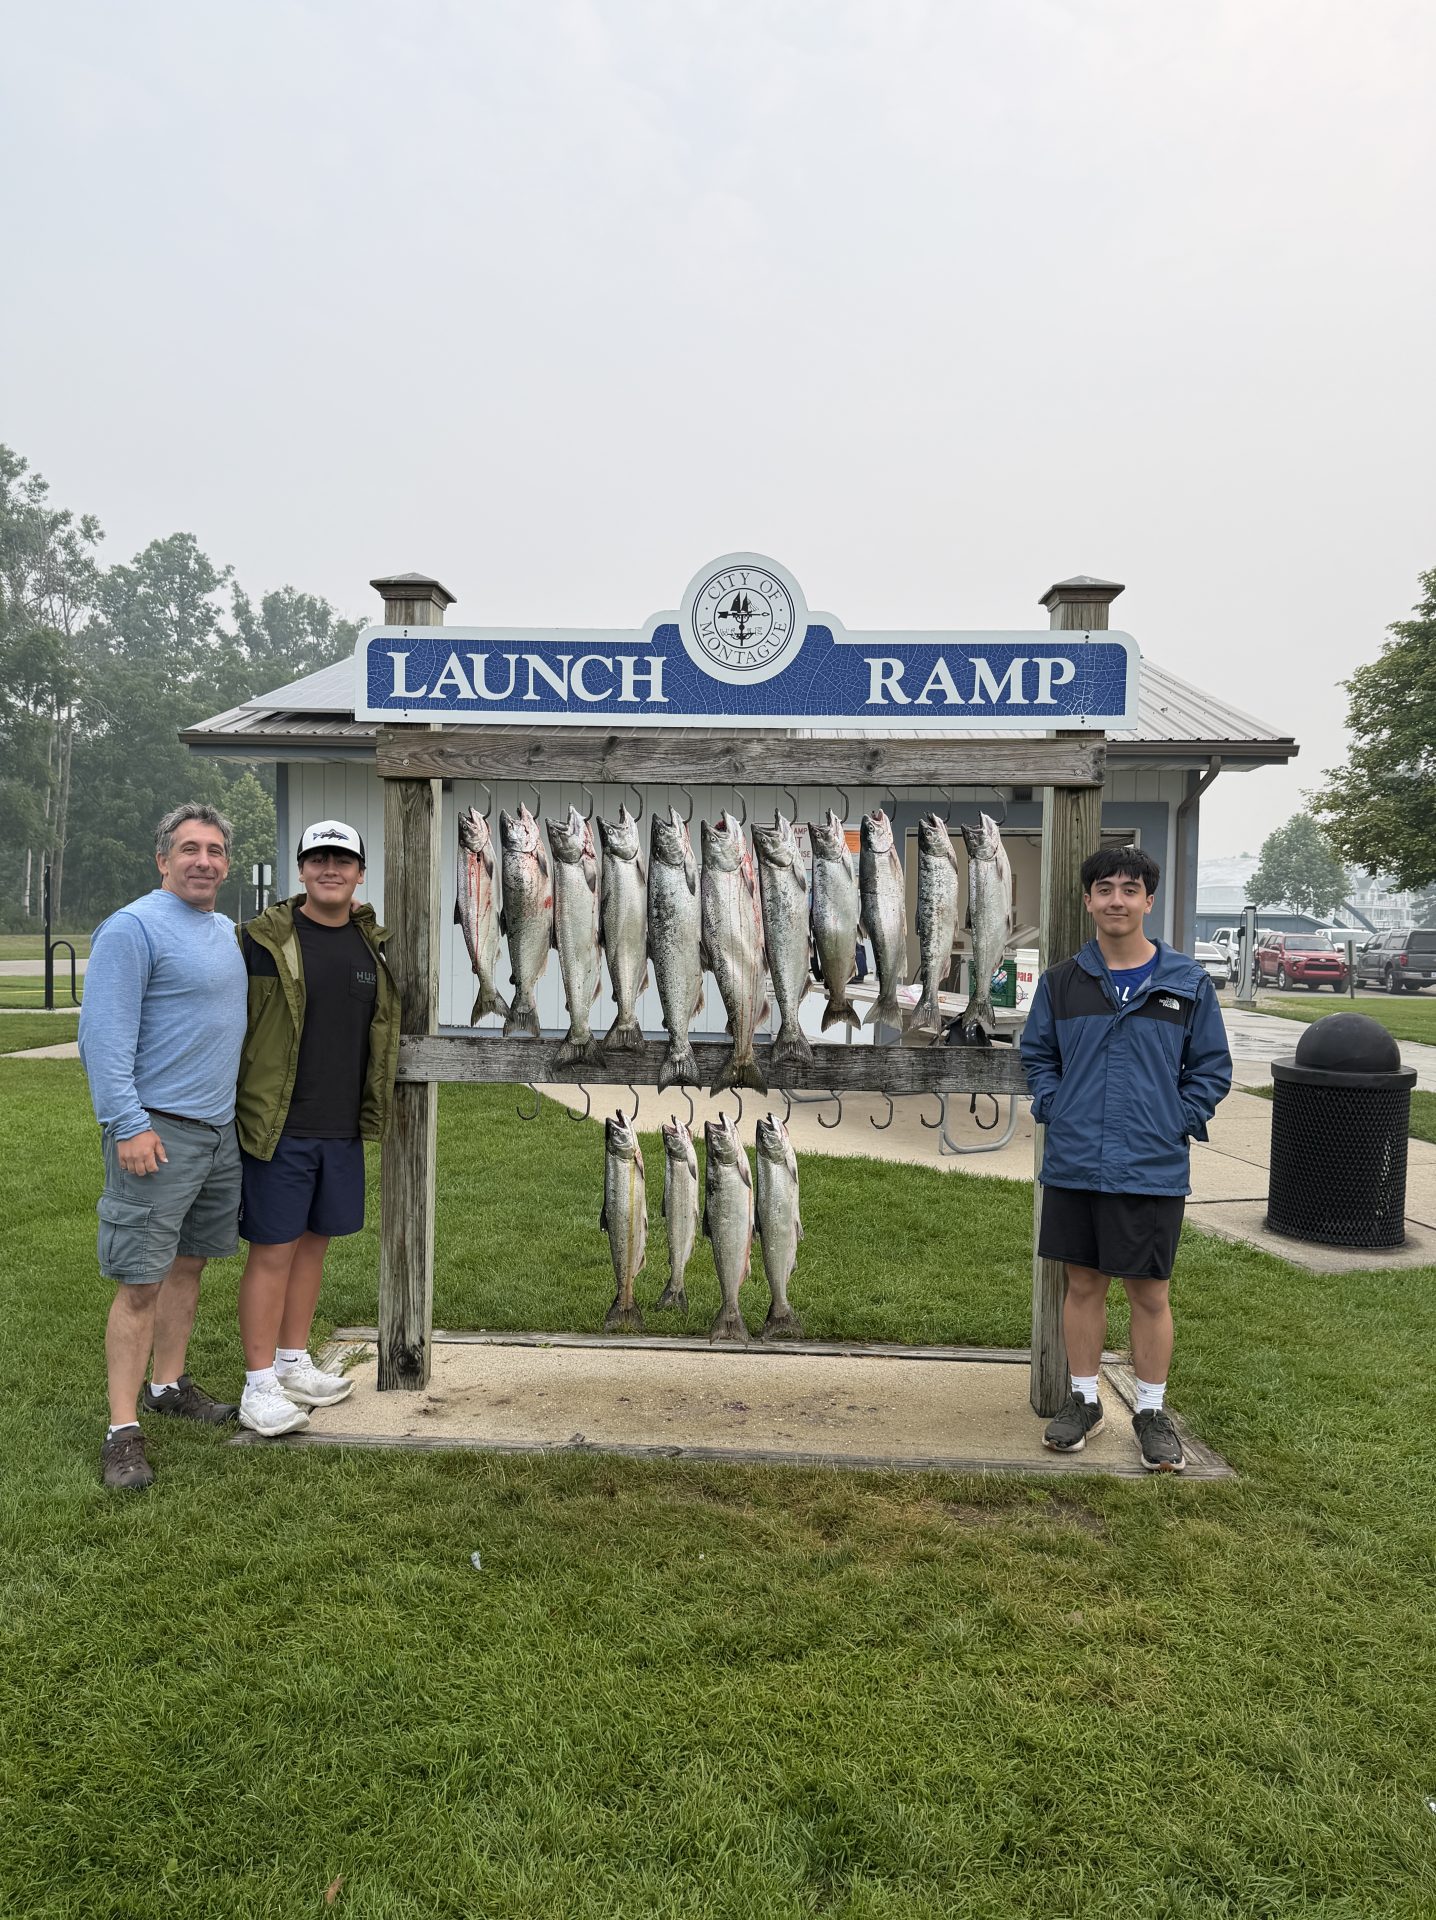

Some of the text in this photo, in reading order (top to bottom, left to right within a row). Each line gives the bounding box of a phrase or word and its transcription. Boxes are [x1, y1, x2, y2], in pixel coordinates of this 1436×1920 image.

[707, 572, 783, 601] CITY OF
[699, 621, 787, 664] MONTAGUE
[386, 651, 1076, 705] LAUNCH RAMP
